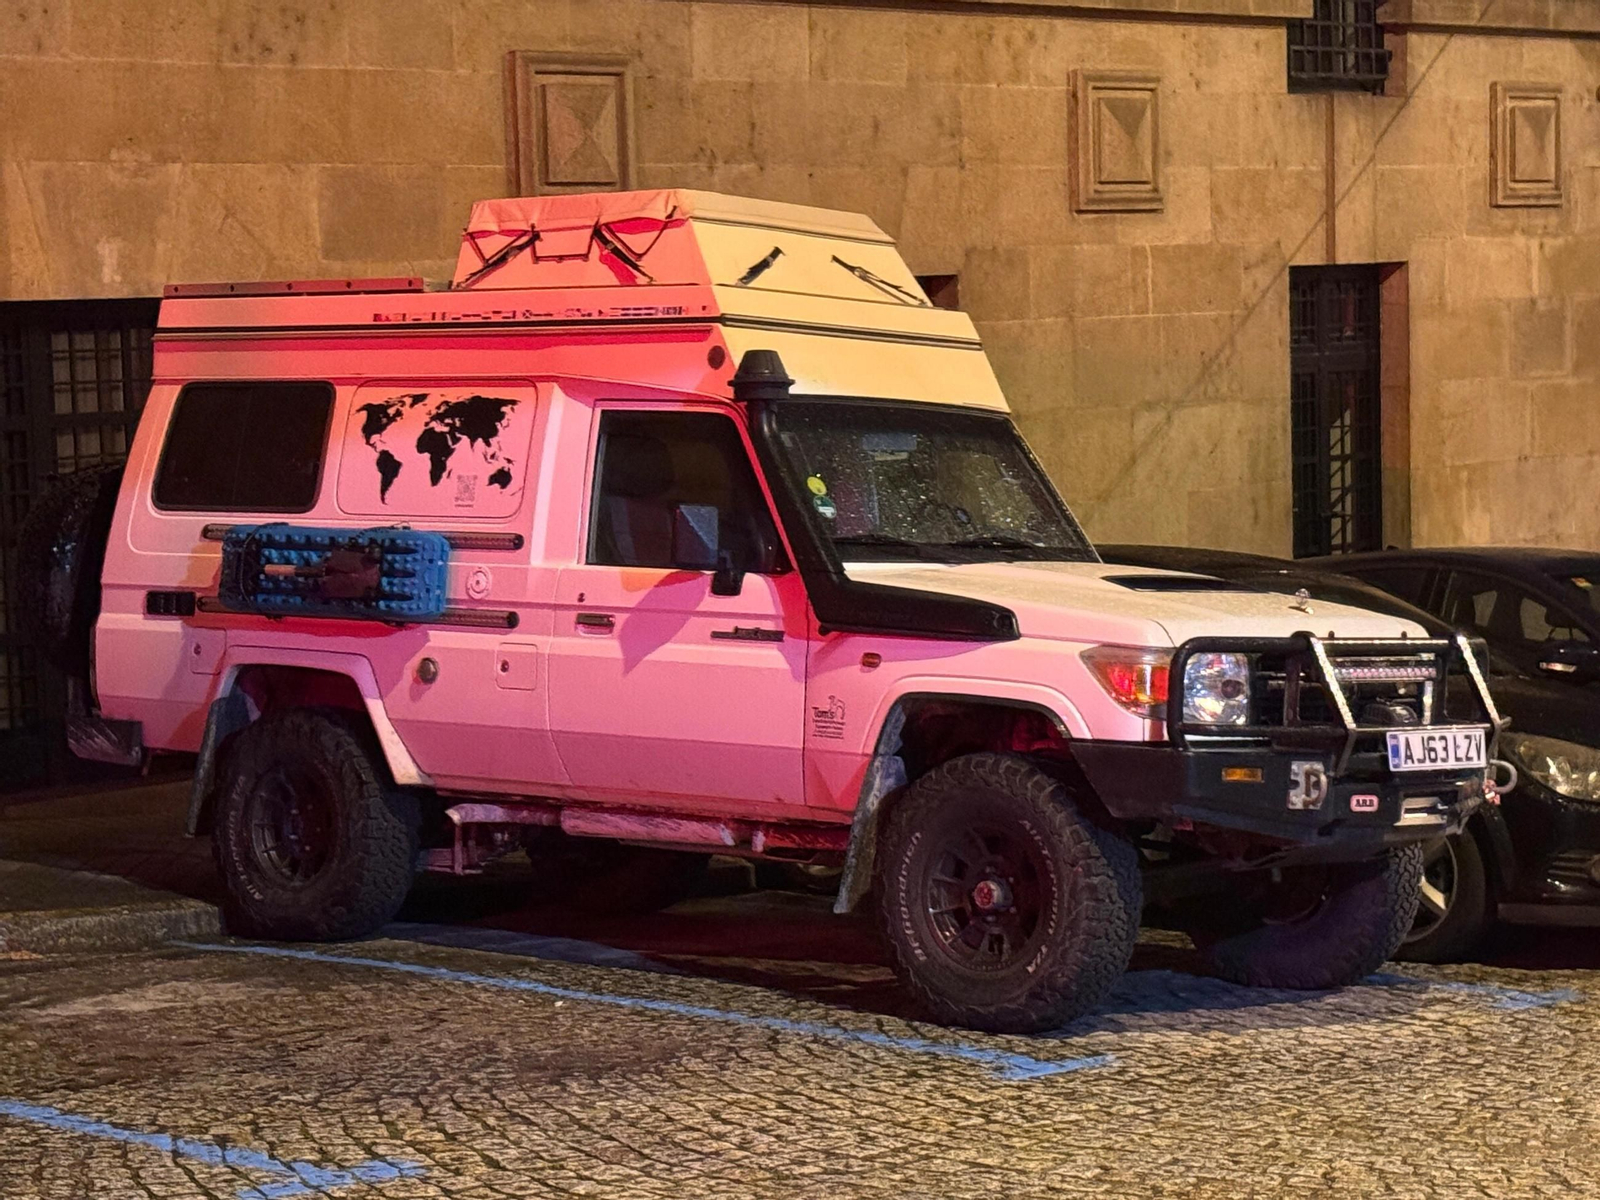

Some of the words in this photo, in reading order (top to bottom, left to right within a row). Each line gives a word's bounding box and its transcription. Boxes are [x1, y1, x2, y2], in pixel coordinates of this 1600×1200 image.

[1404, 735, 1449, 765] AJ63
[1453, 733, 1482, 762] LZV
[1354, 798, 1375, 807] ARB
[897, 832, 928, 962] BFGoodrich
